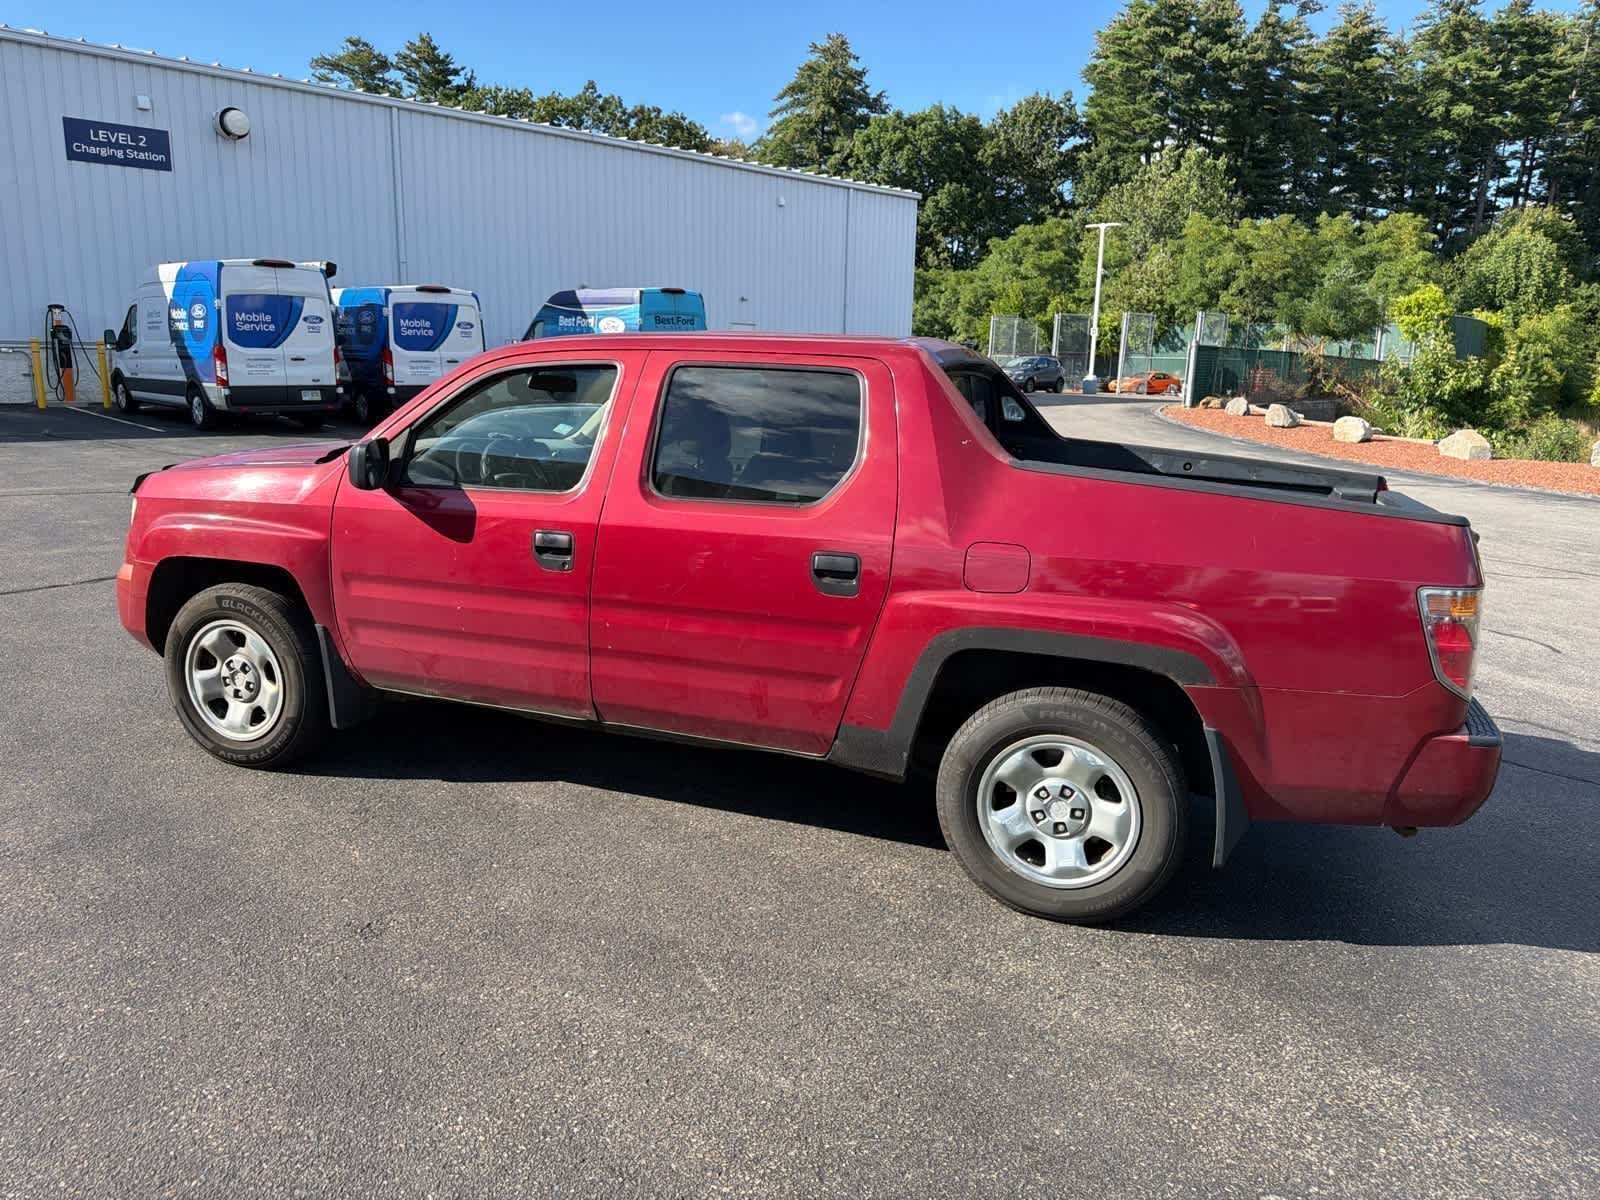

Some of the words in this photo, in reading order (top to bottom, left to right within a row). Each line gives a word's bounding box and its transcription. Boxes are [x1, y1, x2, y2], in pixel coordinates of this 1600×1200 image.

[89, 129, 136, 146] LEVEL
[138, 135, 147, 147] 2
[72, 142, 124, 159] Charging
[126, 149, 166, 162] Station
[235, 312, 272, 322] Mobile
[558, 315, 575, 327] Best
[576, 316, 594, 328] Ford
[655, 315, 674, 325] Best
[676, 316, 695, 326] Ford
[235, 321, 276, 332] Service
[400, 318, 431, 328] Mobile
[400, 327, 434, 337] Service
